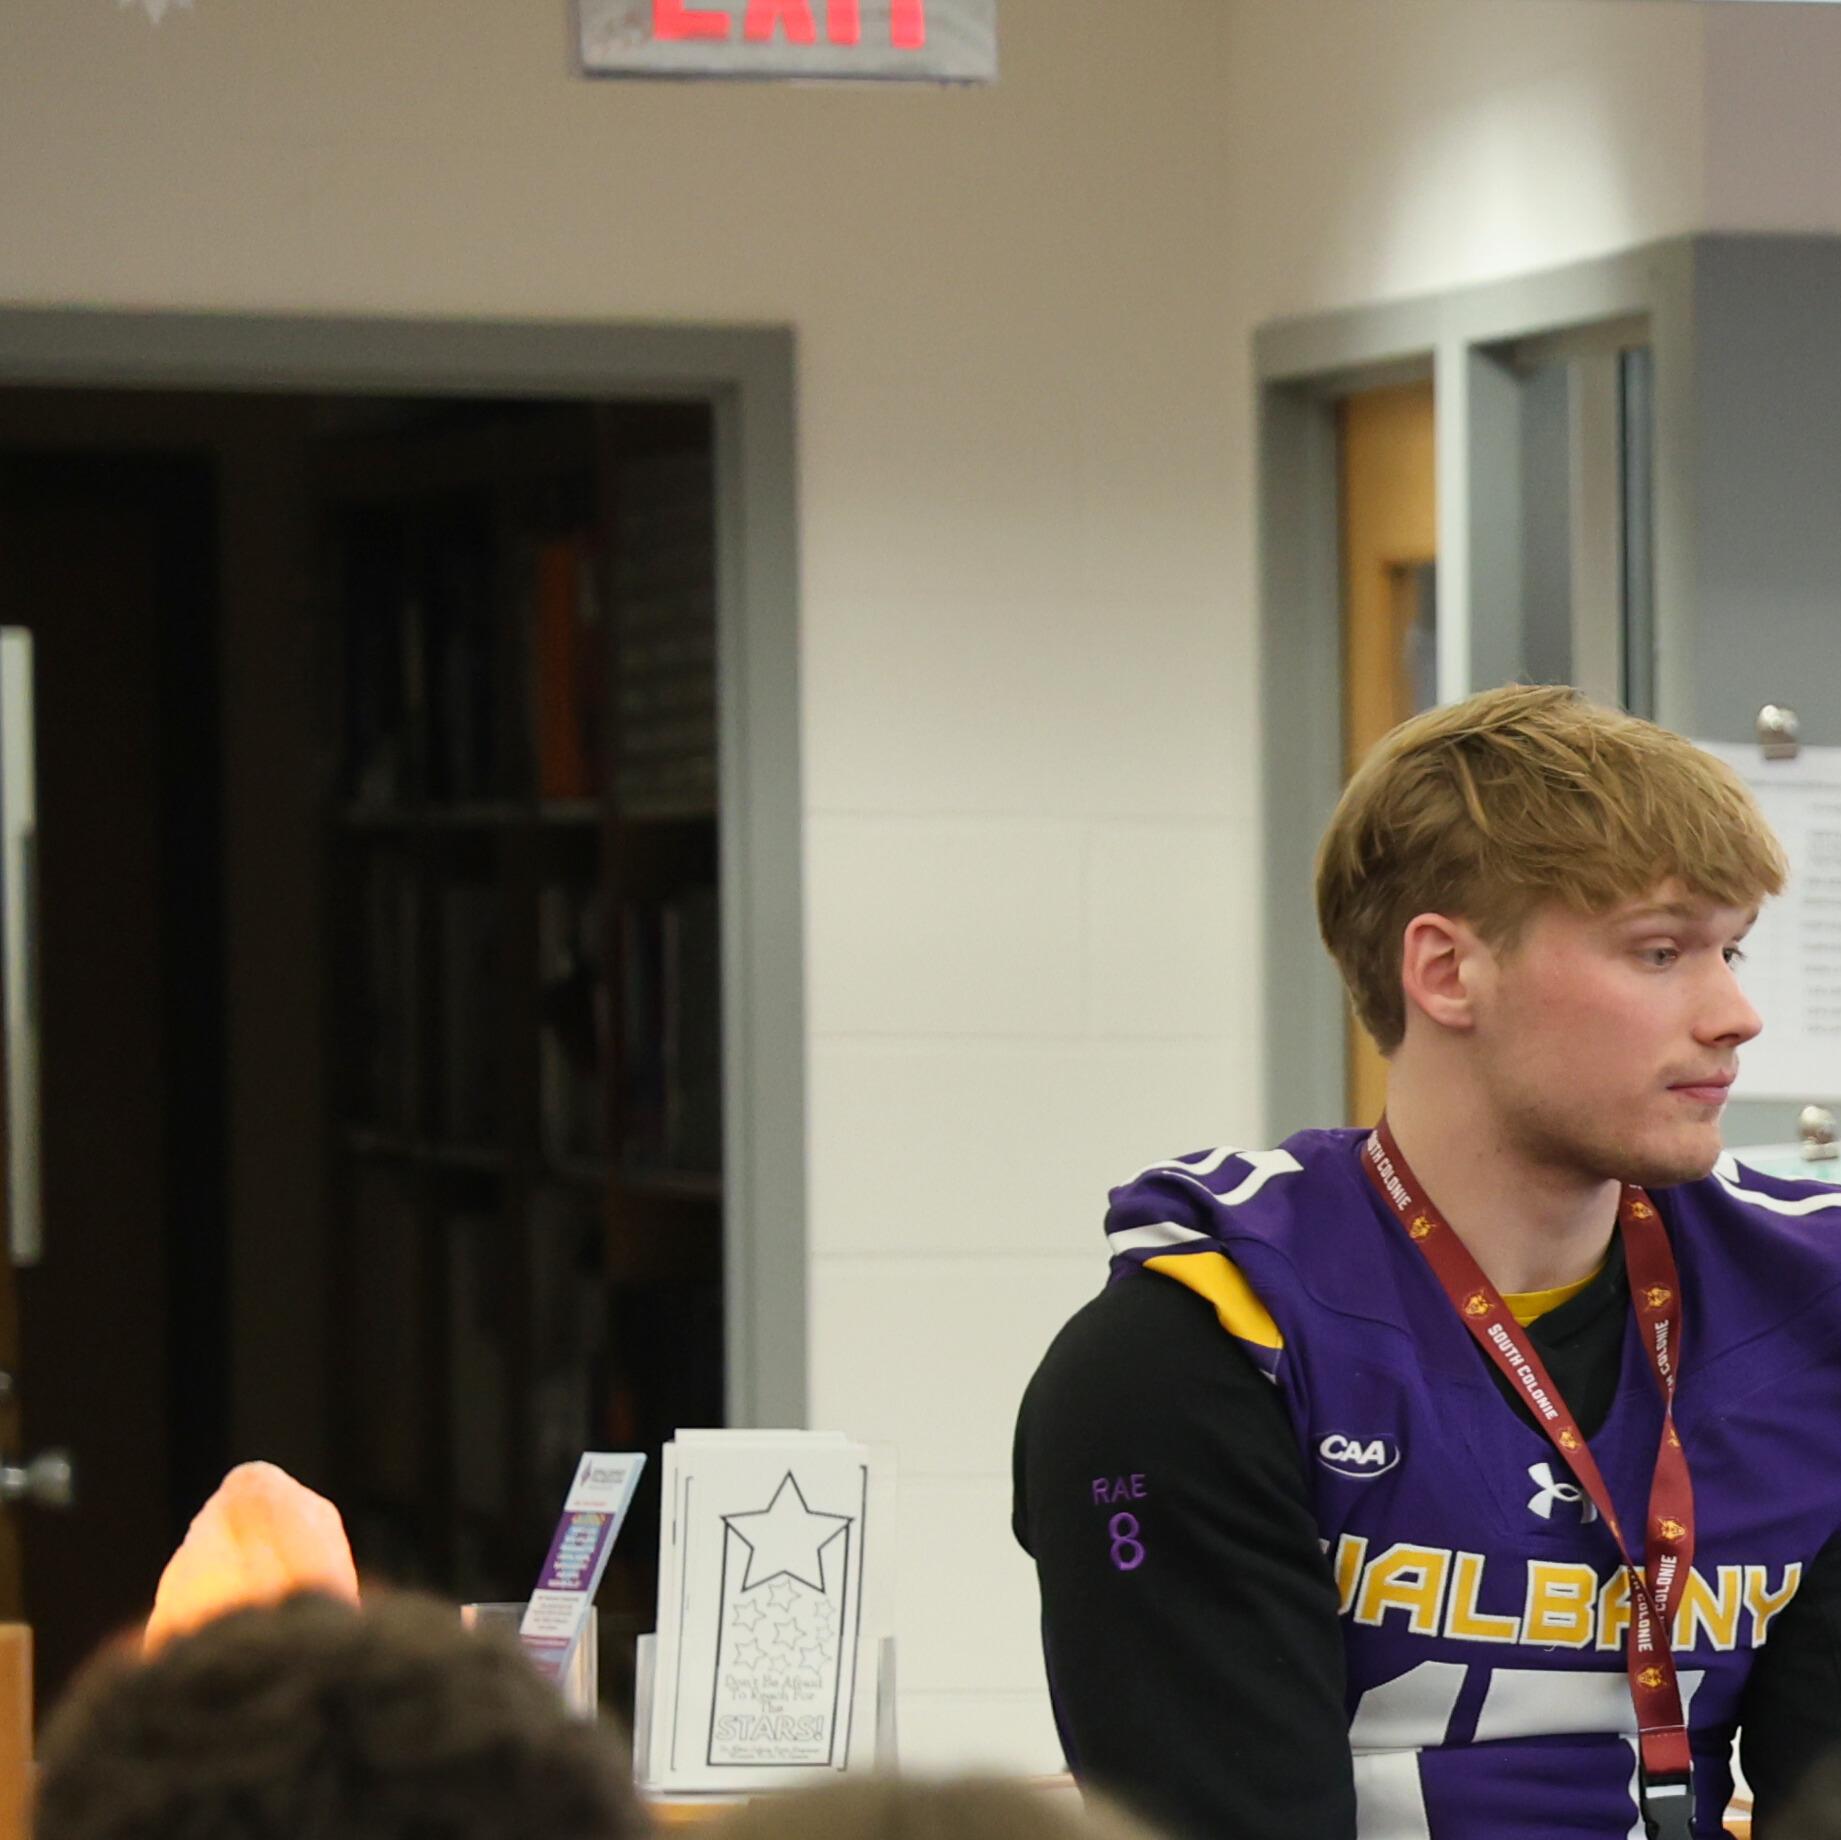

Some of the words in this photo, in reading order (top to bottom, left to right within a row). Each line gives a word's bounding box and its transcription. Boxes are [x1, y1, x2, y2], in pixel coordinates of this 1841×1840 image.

[1377, 1157, 1412, 1211] COLONIE
[1487, 1323, 1525, 1367] SOUTH
[1517, 1365, 1559, 1420] COLONIE
[1319, 1434, 1386, 1466] CAA
[1092, 1473, 1149, 1505] RAE
[1108, 1511, 1145, 1571] 8
[1654, 1554, 1677, 1612] COLONIE
[1637, 1592, 1653, 1652] COLONIE
[715, 1714, 825, 1742] STARS!
